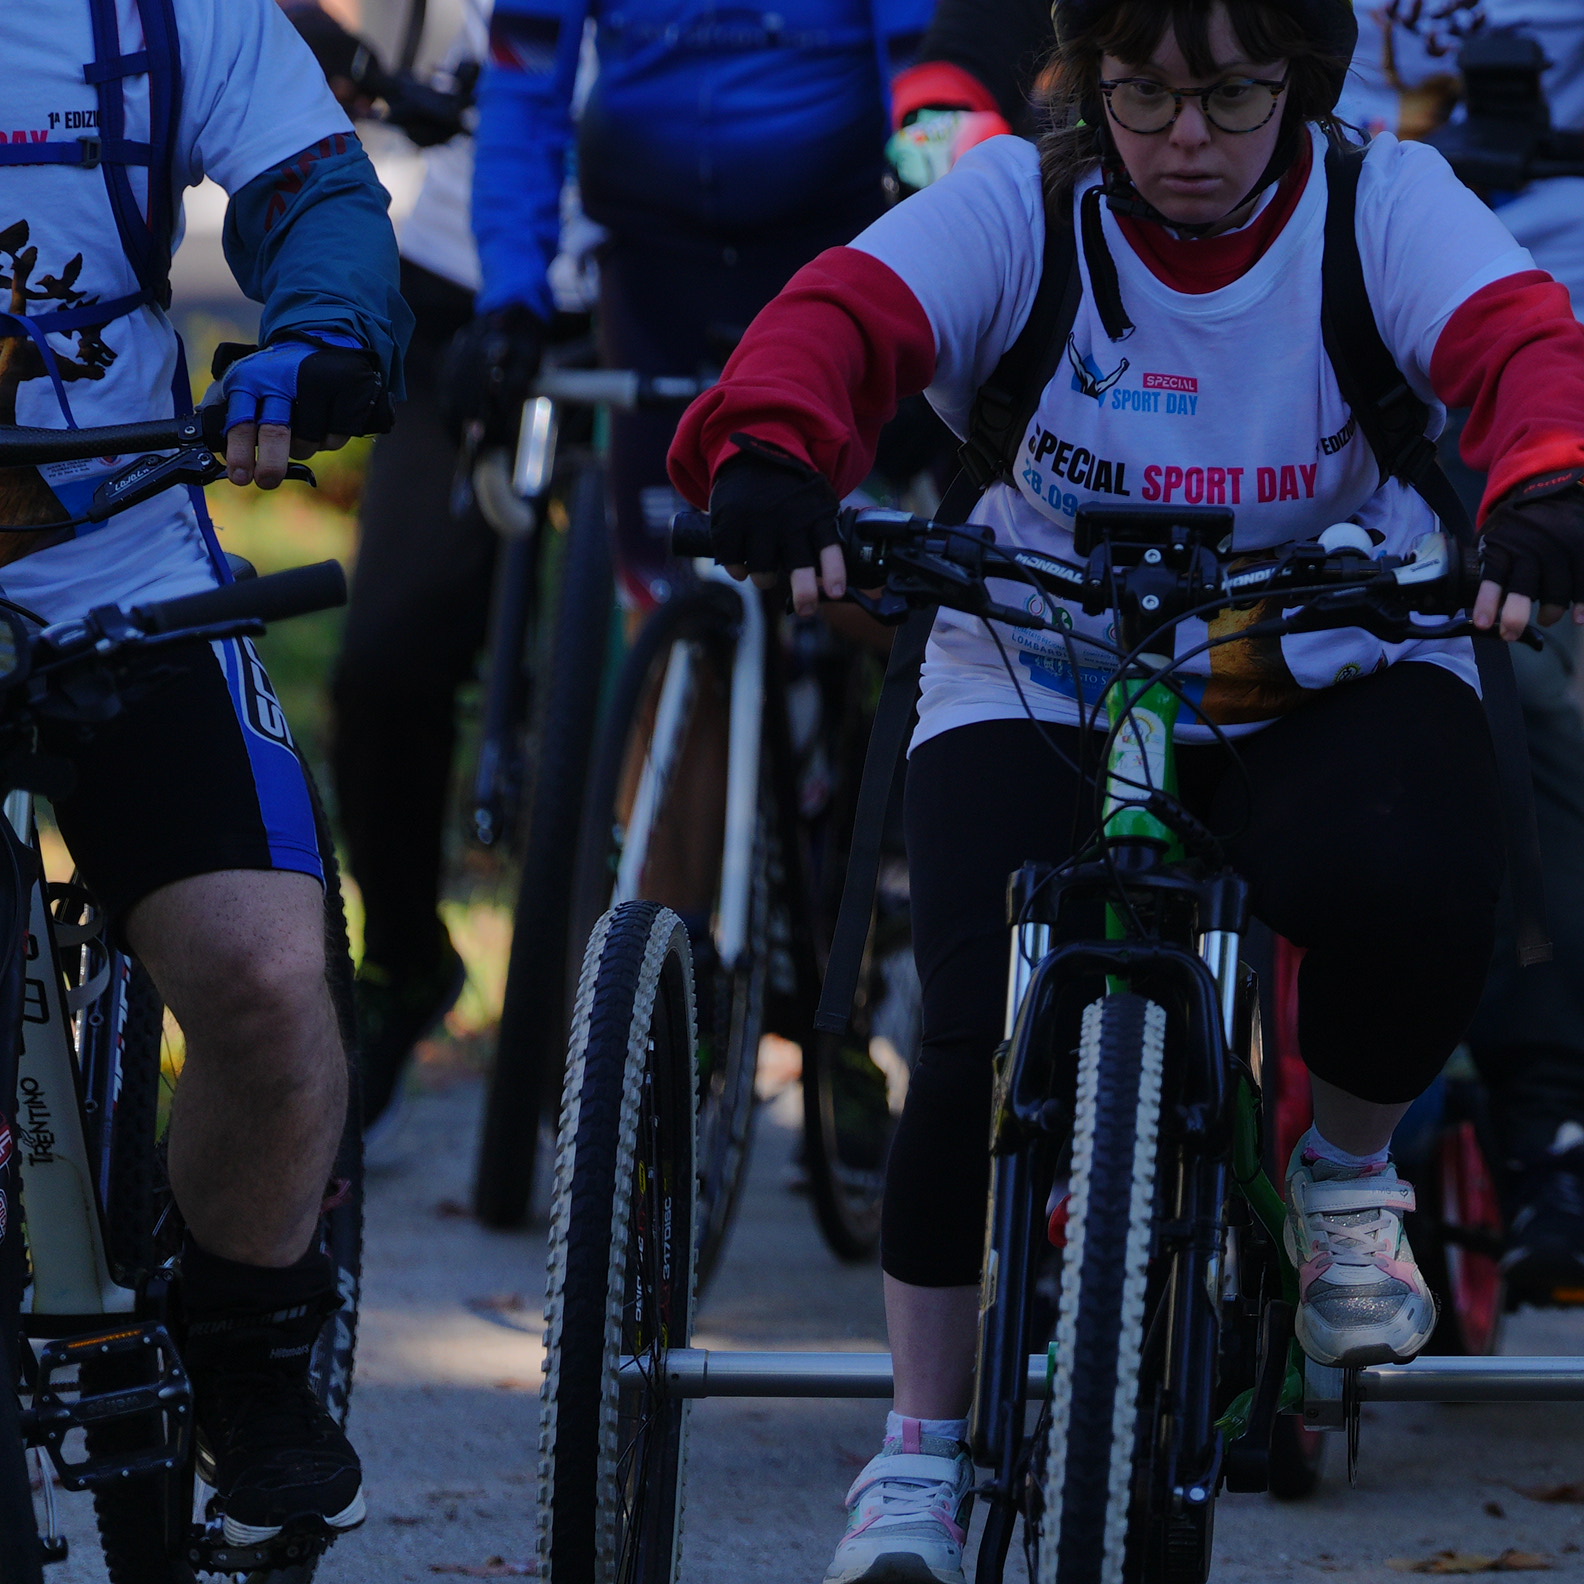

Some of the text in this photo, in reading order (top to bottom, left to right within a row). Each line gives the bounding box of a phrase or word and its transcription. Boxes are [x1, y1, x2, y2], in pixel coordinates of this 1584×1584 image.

[1146, 375, 1195, 391] SPECIAL
[1112, 389, 1198, 416] SPORT DAY
[1142, 465, 1244, 504] SPORT
[1257, 463, 1318, 503] DAY
[20, 1077, 54, 1166] TRENTINO
